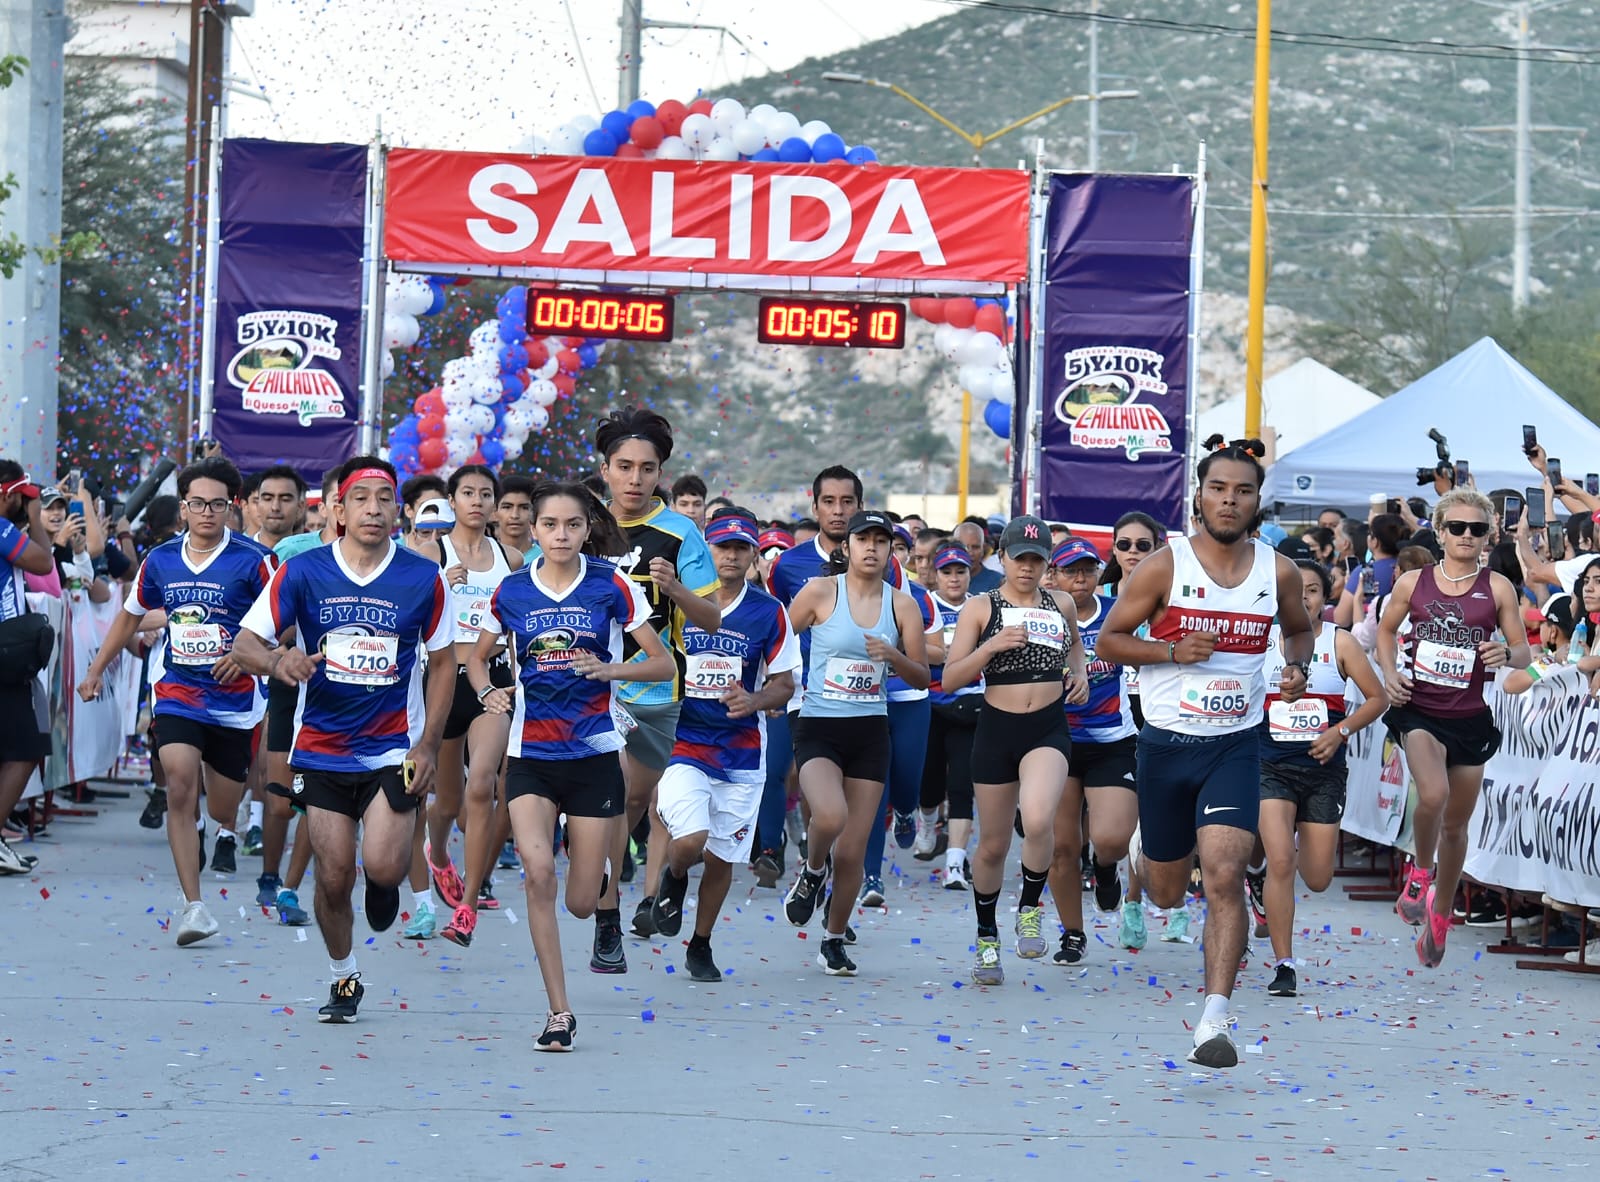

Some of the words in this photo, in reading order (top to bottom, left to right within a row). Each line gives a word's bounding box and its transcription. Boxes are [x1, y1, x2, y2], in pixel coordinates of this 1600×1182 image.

[465, 163, 948, 267] SALIDA
[535, 297, 664, 332] 00:00:06
[242, 322, 255, 340] 5
[263, 320, 279, 336] Y
[286, 320, 332, 343] 10K
[1069, 358, 1082, 375] 5
[1090, 356, 1105, 371] Y
[1114, 356, 1158, 378] 10K
[247, 370, 338, 396] CHILCHOTA
[253, 400, 289, 410] Queso
[1075, 407, 1166, 431] CHILCHOTA
[1081, 435, 1116, 445] Queso
[1024, 523, 1039, 539] NY
[165, 591, 174, 604] 5
[177, 589, 190, 602] Y
[192, 589, 223, 606] 10K
[320, 607, 333, 624] 5
[336, 605, 352, 621] Y
[356, 606, 396, 629] 10K
[526, 617, 537, 632] 5
[541, 615, 554, 627] Y
[557, 614, 592, 629] 10K
[1179, 615, 1229, 633] RODOLFO
[1023, 621, 1058, 635] 1899
[1416, 622, 1484, 645] CHICO
[181, 641, 217, 653] 1502
[695, 634, 709, 648] Y
[712, 636, 748, 657] 10K
[347, 654, 389, 671] 1710
[1434, 661, 1464, 676] 1811
[847, 676, 872, 689] 786
[1201, 695, 1244, 711] 1605
[1289, 715, 1320, 728] 750
